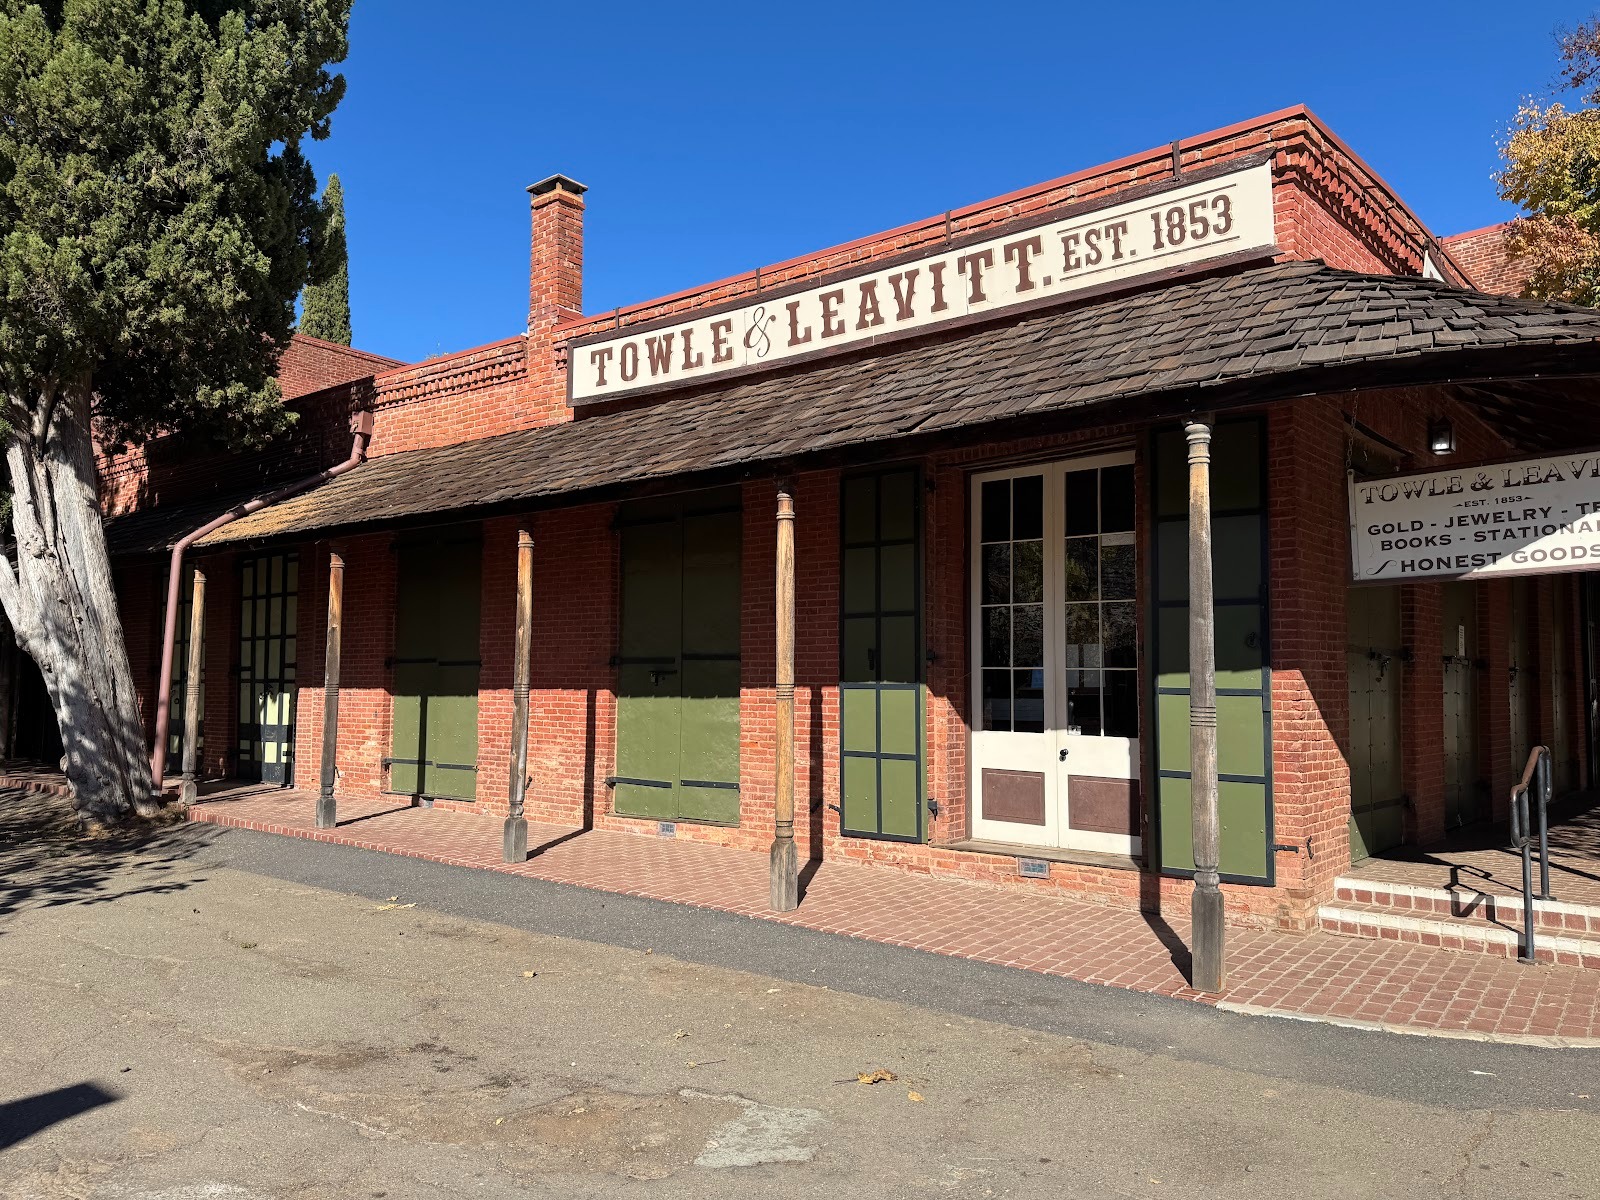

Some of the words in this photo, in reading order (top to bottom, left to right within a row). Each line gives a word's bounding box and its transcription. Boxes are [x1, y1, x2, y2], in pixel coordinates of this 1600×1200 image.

[1061, 220, 1136, 273] EST.
[1151, 194, 1234, 250] 1853
[590, 319, 734, 387] TOWLE
[744, 306, 776, 358] &
[785, 235, 1052, 347] LEAVITT.
[1360, 475, 1464, 504] TOWLE
[1470, 472, 1495, 492] &
[1464, 499, 1490, 508] EST.
[1495, 495, 1523, 505] 1853
[1367, 520, 1424, 536] GOLD
[1444, 506, 1552, 528] JEWELRY
[1381, 534, 1452, 552] BOOKS
[1400, 552, 1502, 573] HONEST
[1511, 544, 1600, 564] GOODS
